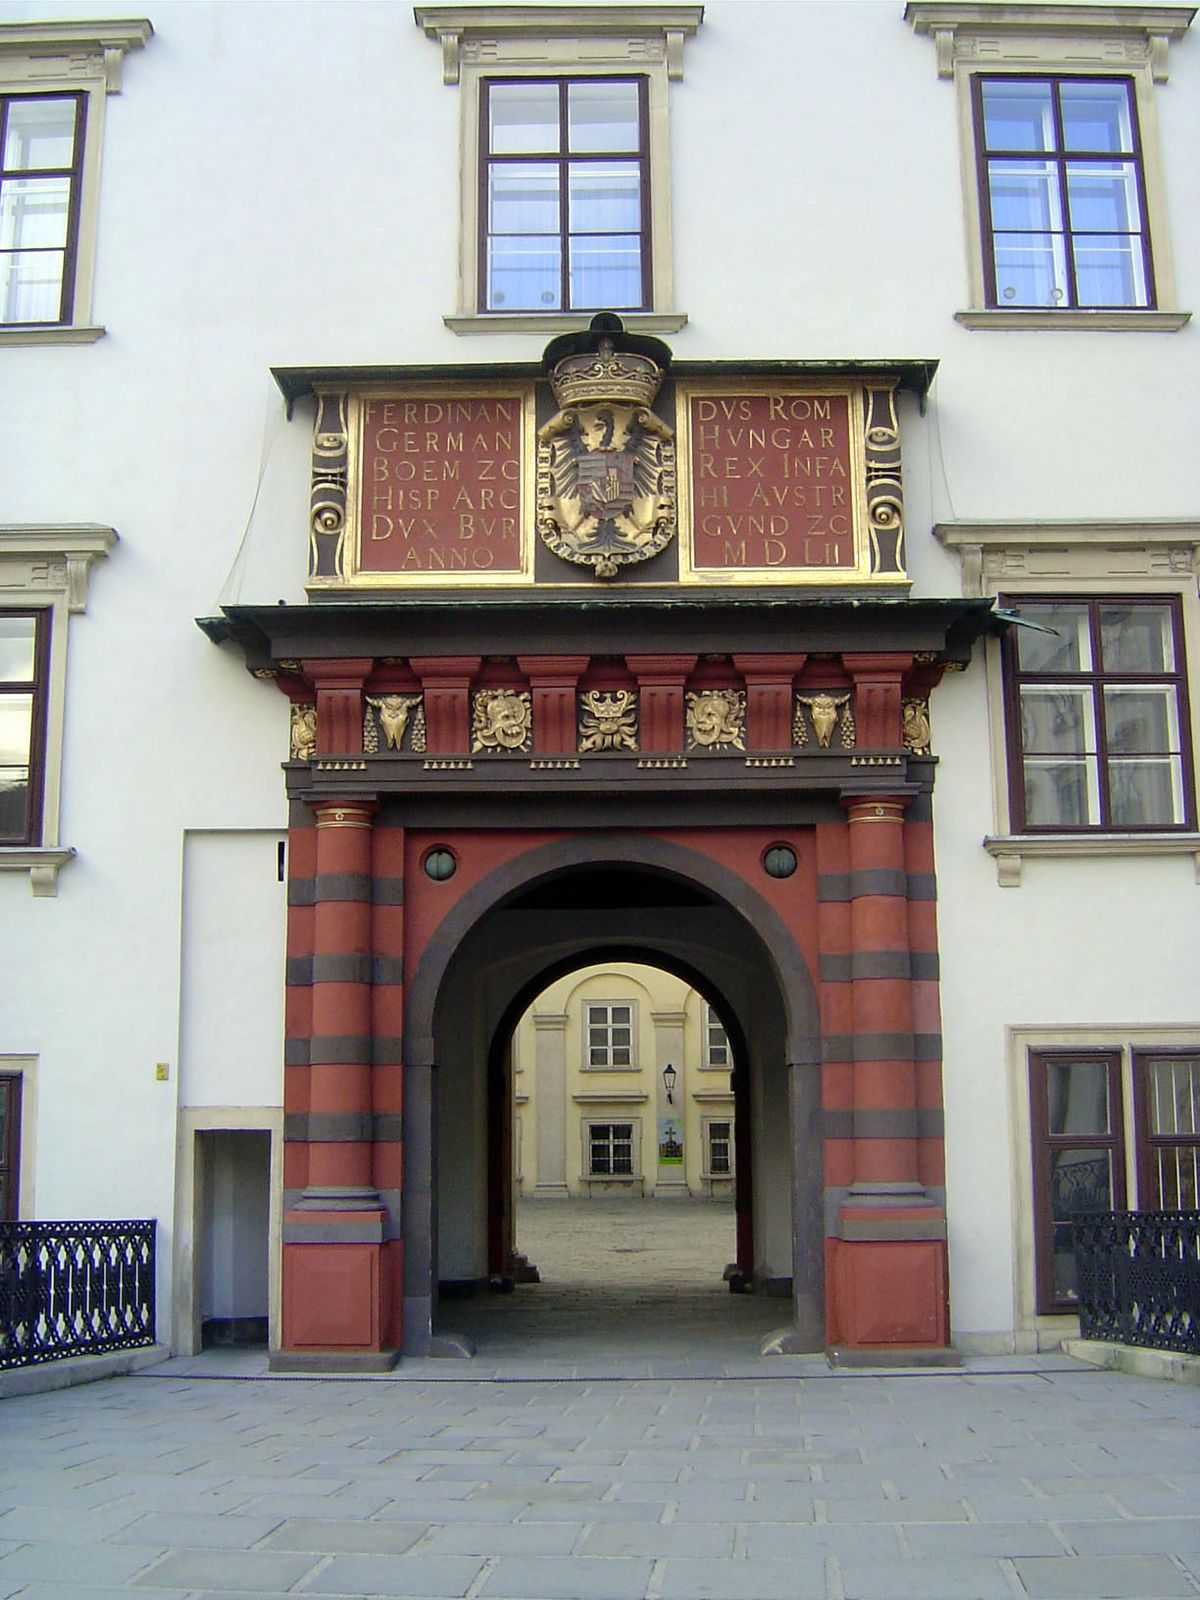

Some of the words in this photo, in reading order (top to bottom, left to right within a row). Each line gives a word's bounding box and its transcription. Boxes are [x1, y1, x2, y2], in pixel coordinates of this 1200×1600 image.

[365, 401, 512, 424] FERDINAN
[699, 400, 752, 421] DVS
[769, 396, 832, 421] ROM
[375, 428, 512, 453] GERMAN
[700, 425, 835, 449] HVNGAR
[373, 456, 461, 482] BOEM
[477, 460, 520, 480] ZC
[700, 453, 765, 479] REX
[783, 453, 847, 478] INFA
[373, 486, 440, 511] HISP
[452, 486, 518, 510] ARC
[700, 486, 729, 507] HI
[750, 483, 846, 507] AVSTR
[371, 514, 438, 540] DVX
[459, 513, 516, 539] BVR
[702, 514, 789, 537] GVND
[806, 515, 848, 535] ZC
[401, 547, 494, 569] ANNO
[724, 540, 746, 566] M
[764, 539, 787, 566] D
